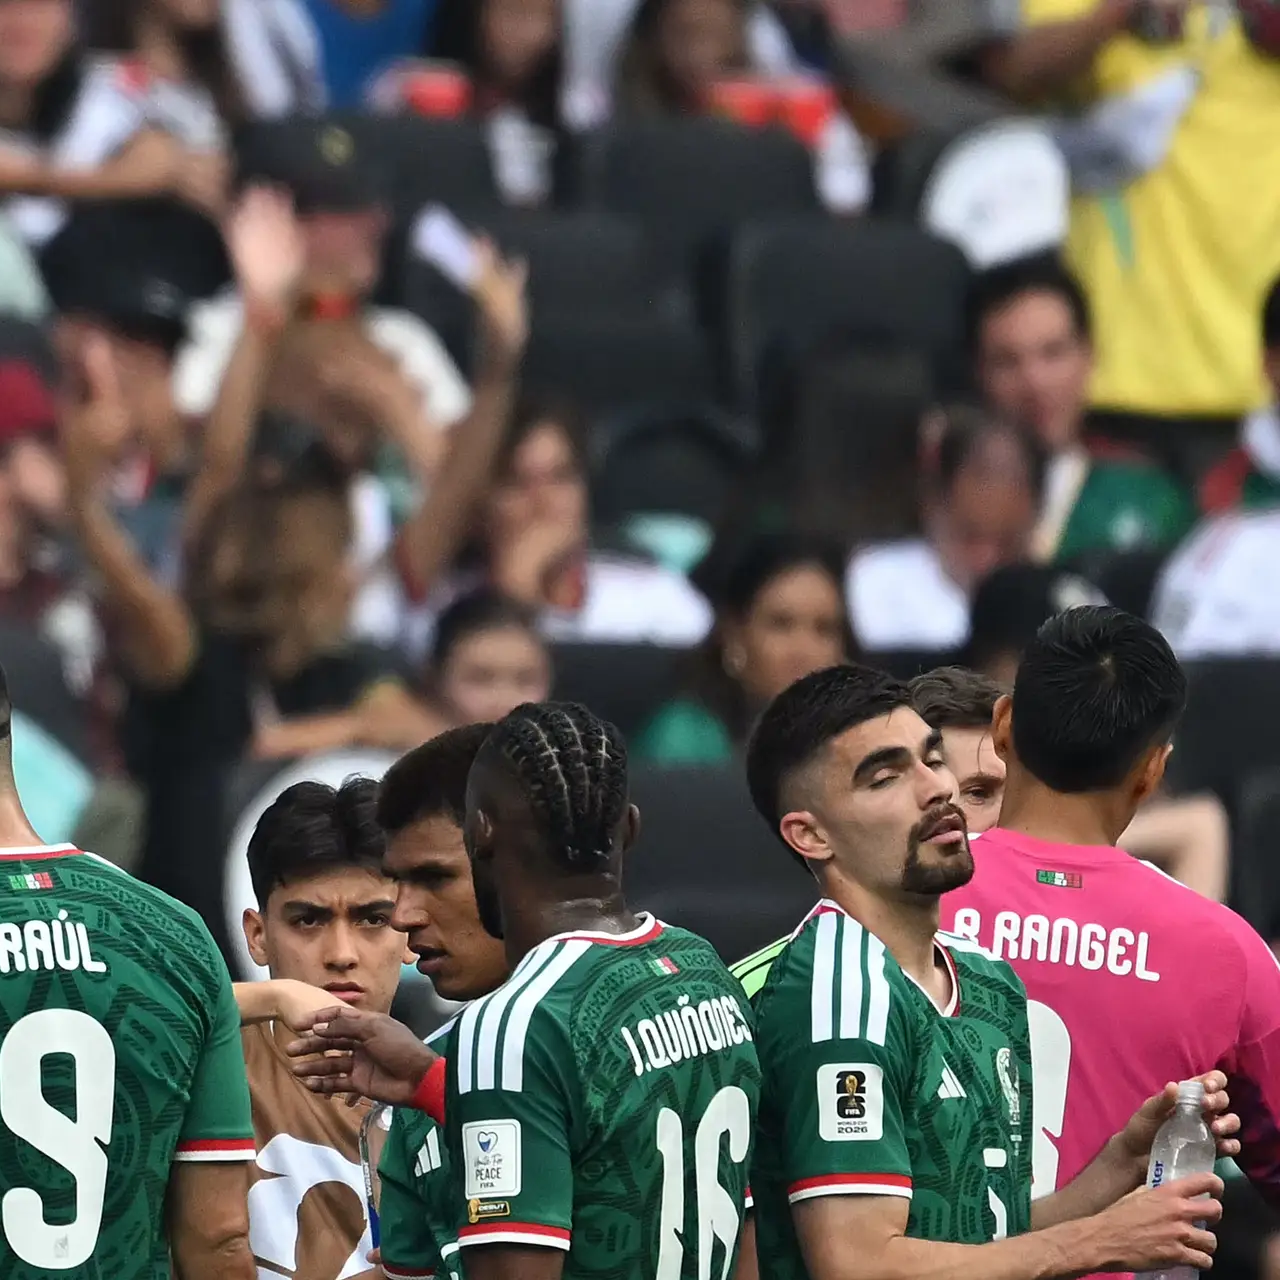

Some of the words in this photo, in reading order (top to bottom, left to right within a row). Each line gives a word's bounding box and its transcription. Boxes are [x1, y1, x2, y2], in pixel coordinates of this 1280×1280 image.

[621, 994, 752, 1076] J.QUIÑONES
[0, 1008, 115, 1269] 9
[837, 1126, 868, 1134] 2026
[475, 1167, 502, 1180] PEACE
